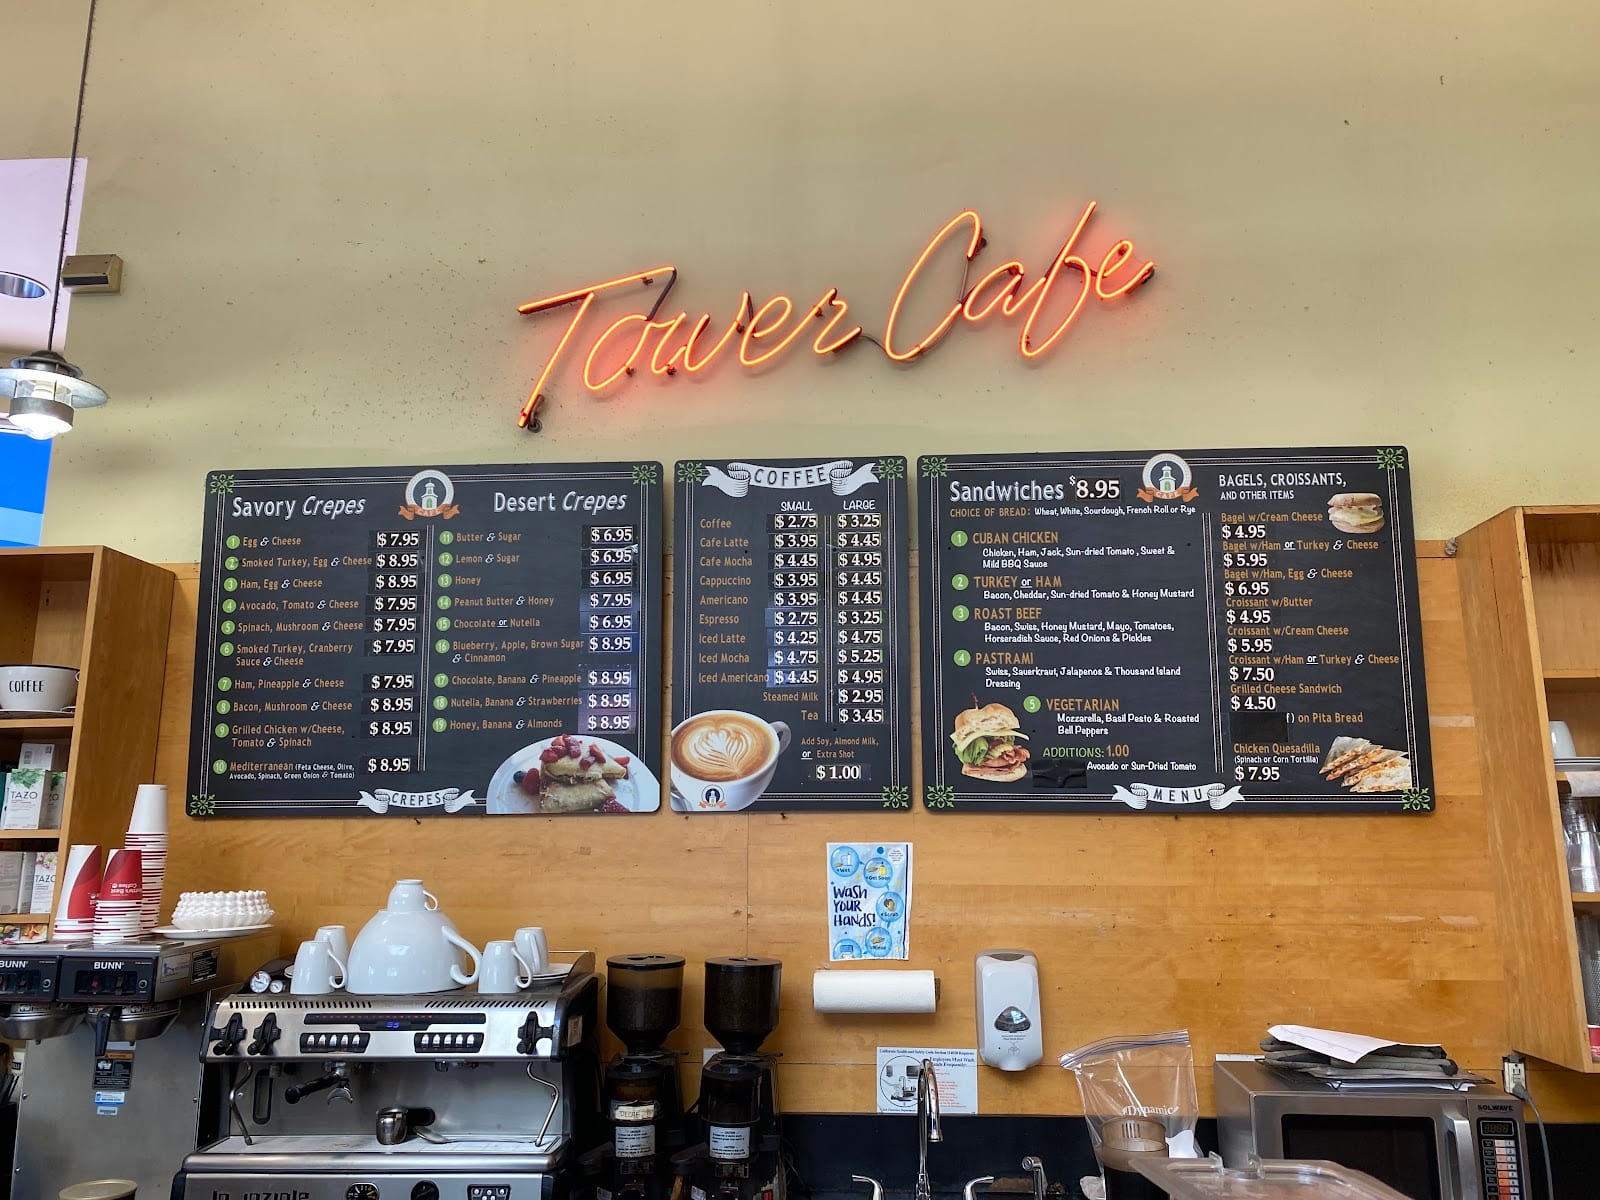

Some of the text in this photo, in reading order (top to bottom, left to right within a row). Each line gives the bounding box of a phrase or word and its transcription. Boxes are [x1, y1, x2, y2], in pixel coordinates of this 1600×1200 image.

[518, 200, 1156, 429] Tower Cafe
[754, 466, 827, 485] COFFEE
[1219, 473, 1346, 487] BAGELS, CROISSANTS,
[950, 481, 1064, 502] Sandwiches
[1220, 490, 1294, 500] AND OTHER ITEMS
[232, 496, 366, 520] Savory Crepes
[494, 491, 627, 515] Desert Crepes
[781, 501, 813, 511] SMALL
[843, 500, 875, 510] LARGE
[950, 508, 980, 518] CHOICE
[984, 508, 995, 517] OF
[999, 508, 1030, 517] BREAD:
[1035, 507, 1059, 517] Wheat,
[1060, 507, 1082, 517] White,
[1084, 506, 1125, 517] Sourdough,
[1127, 506, 1152, 515] French
[1154, 505, 1168, 514] Roll
[1181, 505, 1196, 515] Rye
[1222, 512, 1323, 523] Bagel w/Cream Cheese
[700, 519, 732, 528] Coffee
[243, 536, 301, 547] Egg & Cheese
[457, 532, 521, 543] Butter & Sugar
[700, 538, 749, 548] Cafe Latte
[973, 532, 1058, 544] CUBAN CHICKEN
[1223, 540, 1378, 551] Bagel w/Ham or Turkey & Cheese
[456, 554, 520, 564] Lemon & Sugar
[700, 556, 752, 567] Cafe Mocha
[455, 576, 481, 586] Honey
[700, 576, 751, 587] Cappuccino
[974, 576, 1062, 588] TURKEY or HAM
[700, 595, 748, 605] Americano
[984, 589, 1194, 600] Bacon, Cheddar, Sun-dried Tomato & Honey Mustard
[1226, 597, 1312, 607] Croissant w/Butter
[974, 608, 1042, 620] ROAST BEEF
[454, 619, 540, 628] Chocolate or Nutella
[699, 615, 739, 625] Espresso
[699, 634, 746, 643] Iced Latte
[237, 643, 352, 654] Smoked Turkey, Cranberry
[699, 653, 749, 663] Iced Mocha
[975, 653, 1033, 664] PASTRAMI
[9, 681, 45, 692] COFFEE
[1230, 684, 1342, 694] Grilled Cheese Sandwich
[763, 692, 818, 702] Steamed Milk
[1047, 699, 1119, 711] VEGETARIAN
[801, 711, 818, 720] Tea
[1058, 713, 1199, 724] Mozzarella, Basil Pesto & Roasted
[1298, 714, 1309, 723] on
[1312, 712, 1331, 722] Pita
[1335, 712, 1364, 722] Bread
[232, 725, 344, 734] Grilled Chicken w/Cheese,
[1058, 726, 1108, 737] Bell Peppers
[817, 738, 831, 746] Soy,
[835, 737, 859, 745] Almond
[862, 737, 879, 745] Milk,
[817, 750, 836, 758] Extra
[838, 750, 854, 758] Shot
[1043, 745, 1129, 758] ADDITIONS: 1.00
[1234, 743, 1320, 754] Chicken Quesadilla
[1235, 755, 1262, 764] (Spinach
[1290, 755, 1318, 763] Tortilla)
[230, 762, 293, 771] Mediterranean
[313, 763, 335, 771] Cheese,
[1087, 762, 1119, 771] Avocado
[1131, 762, 1168, 771] Sun-Dried
[1170, 762, 1197, 771] Tomato
[258, 772, 282, 780] Spinach,
[10, 791, 38, 799] TAZO
[392, 793, 441, 806] CREPES
[1153, 788, 1203, 802] MENU
[94, 962, 122, 970] BUNN
